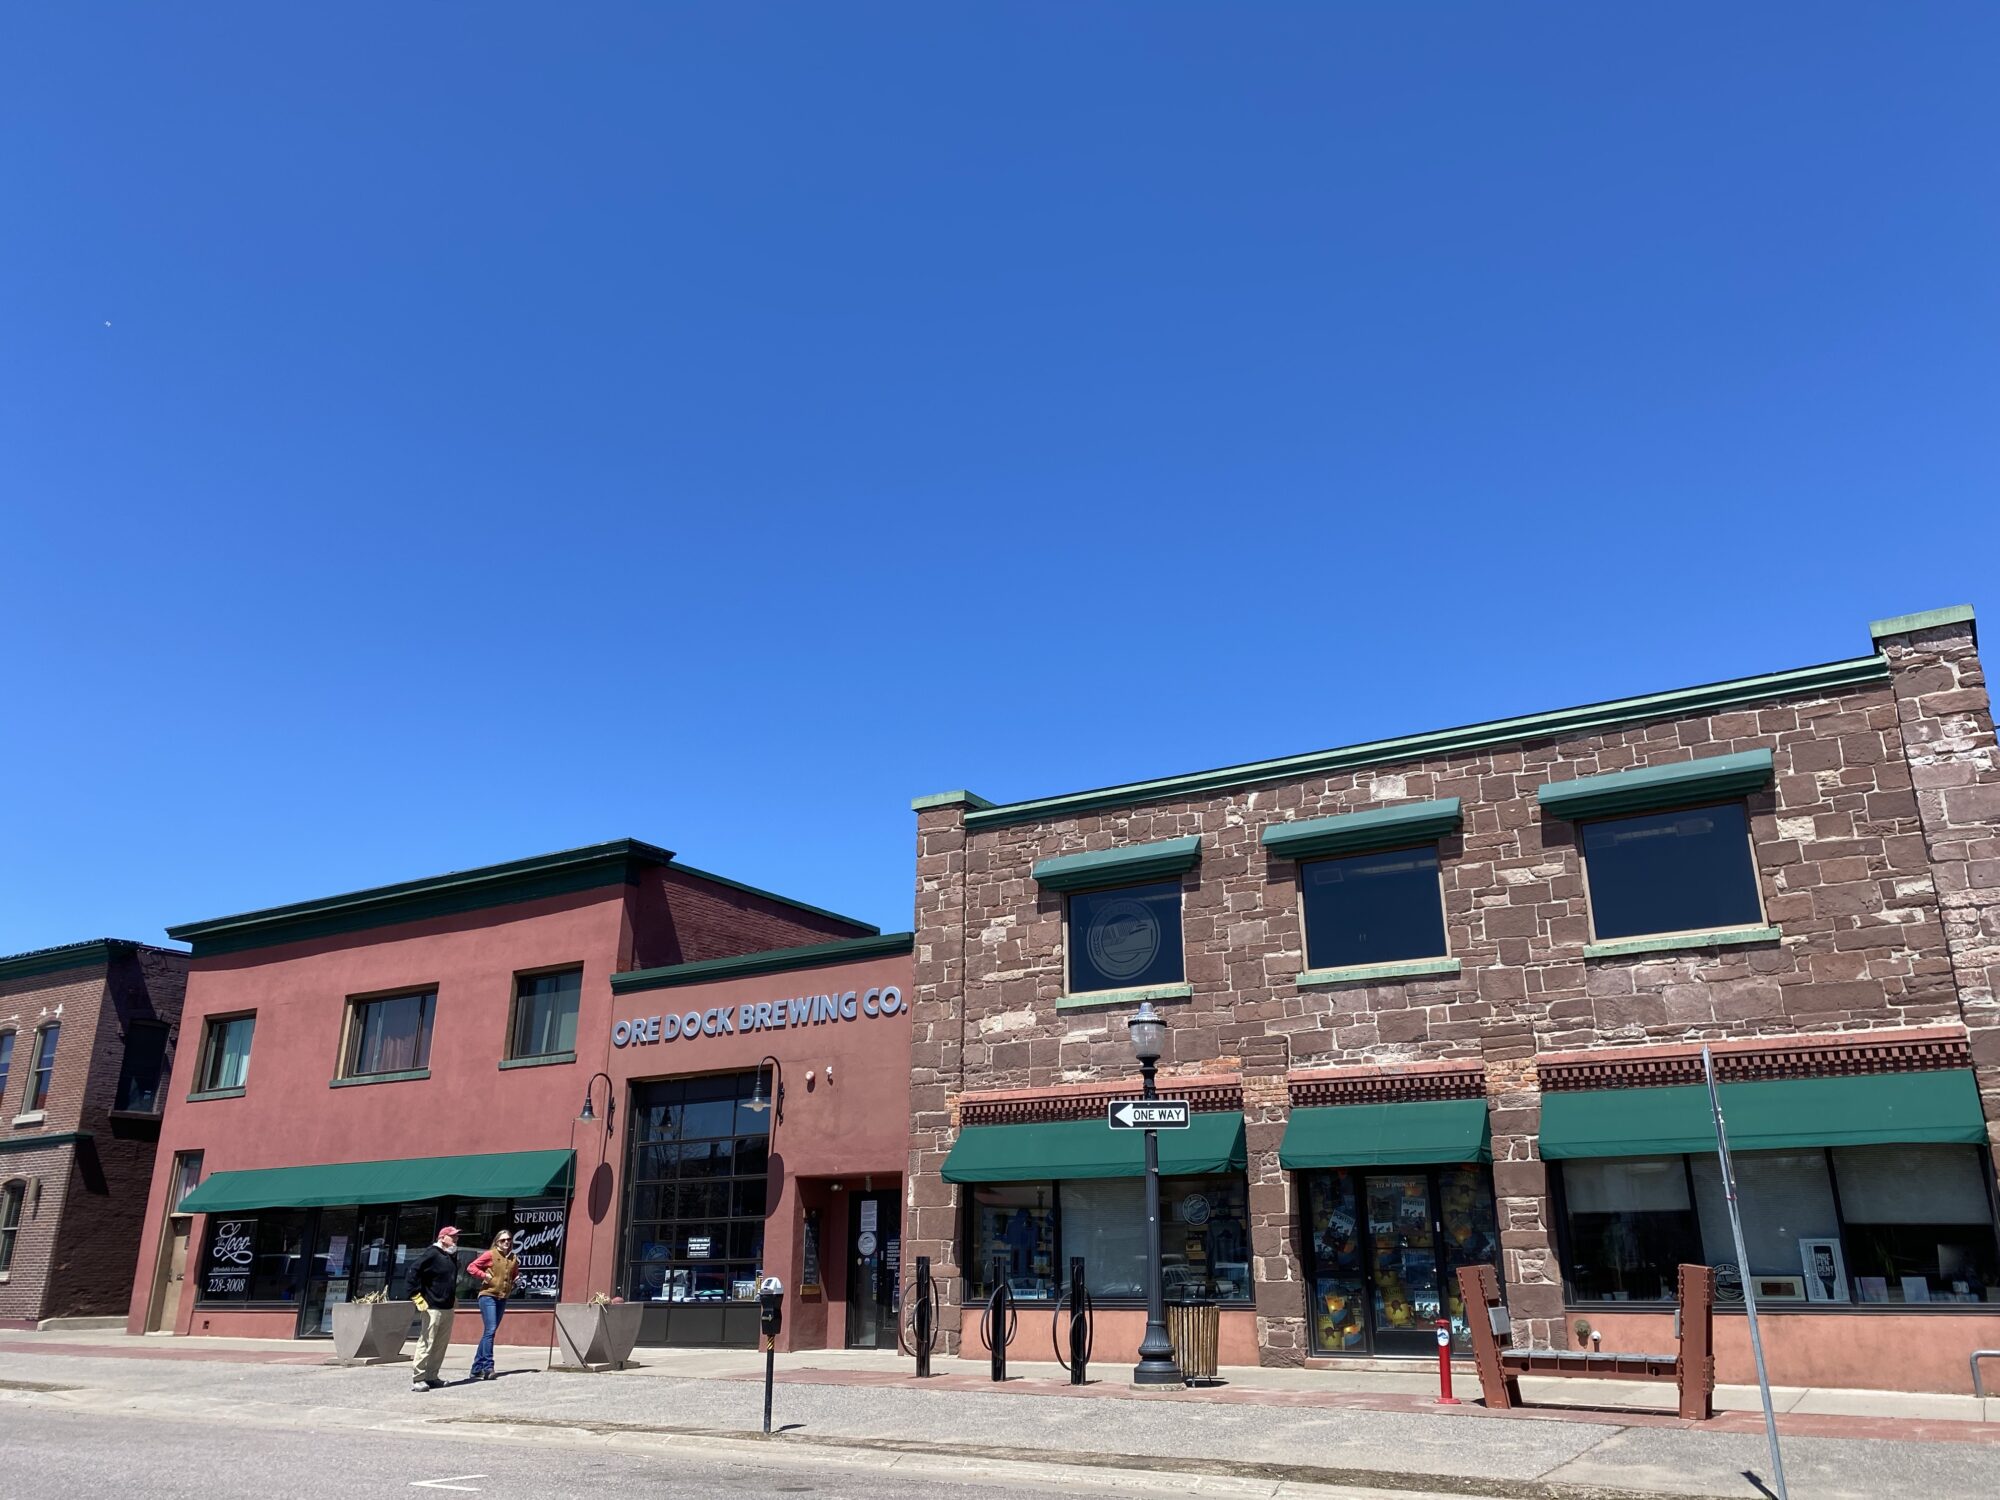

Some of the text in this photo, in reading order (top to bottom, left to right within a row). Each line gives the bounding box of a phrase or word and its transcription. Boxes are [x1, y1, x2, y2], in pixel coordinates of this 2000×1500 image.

[611, 986, 908, 1046] ORE DOCK BREWING CO.
[1133, 1109, 1182, 1121] ONE WAY
[514, 1211, 563, 1223] SUPERIOR
[511, 1224, 564, 1254] Sewing
[516, 1254, 553, 1266] STUDIO
[1815, 1252, 1831, 1260] INDE
[1817, 1265, 1834, 1273] DENT
[207, 1278, 246, 1292] 228-3008
[520, 1274, 557, 1289] 5-5532
